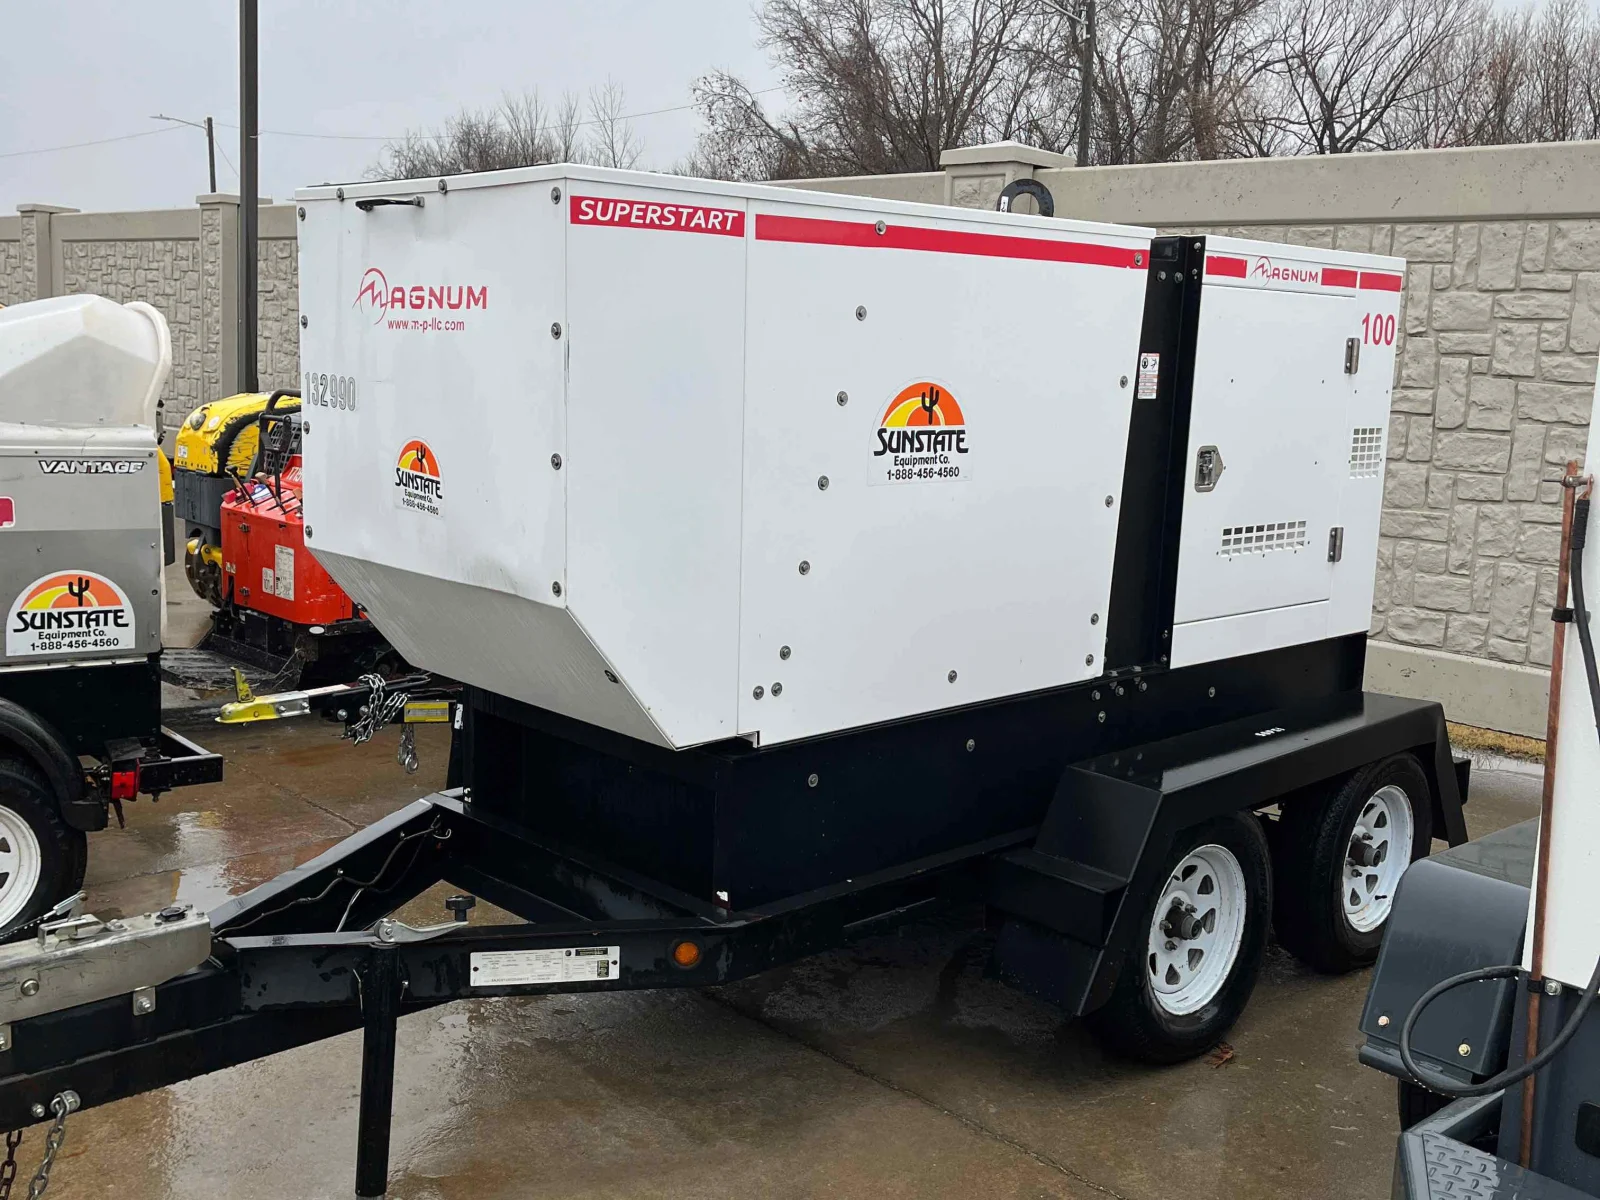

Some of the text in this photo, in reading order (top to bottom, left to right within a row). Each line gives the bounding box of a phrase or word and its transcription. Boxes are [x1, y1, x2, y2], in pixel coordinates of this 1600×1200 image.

[578, 199, 738, 231] SUPERSTART
[1250, 257, 1319, 285] MAGNUM
[352, 269, 488, 321] MAGNUM
[387, 317, 465, 333] www.m-p-llc.com
[1362, 312, 1395, 346] 100
[304, 372, 356, 411] 132990
[873, 428, 969, 456] SUNSTATE
[38, 460, 144, 474] VANTAGE
[887, 466, 960, 481] 1-888-456-4560
[894, 454, 950, 468] Equipment Co.
[395, 467, 443, 499] SUNSTATE
[13, 609, 129, 633] SUNSTATE
[30, 638, 119, 651] 1-888-456-4560
[38, 628, 107, 641] Equipment Co.
